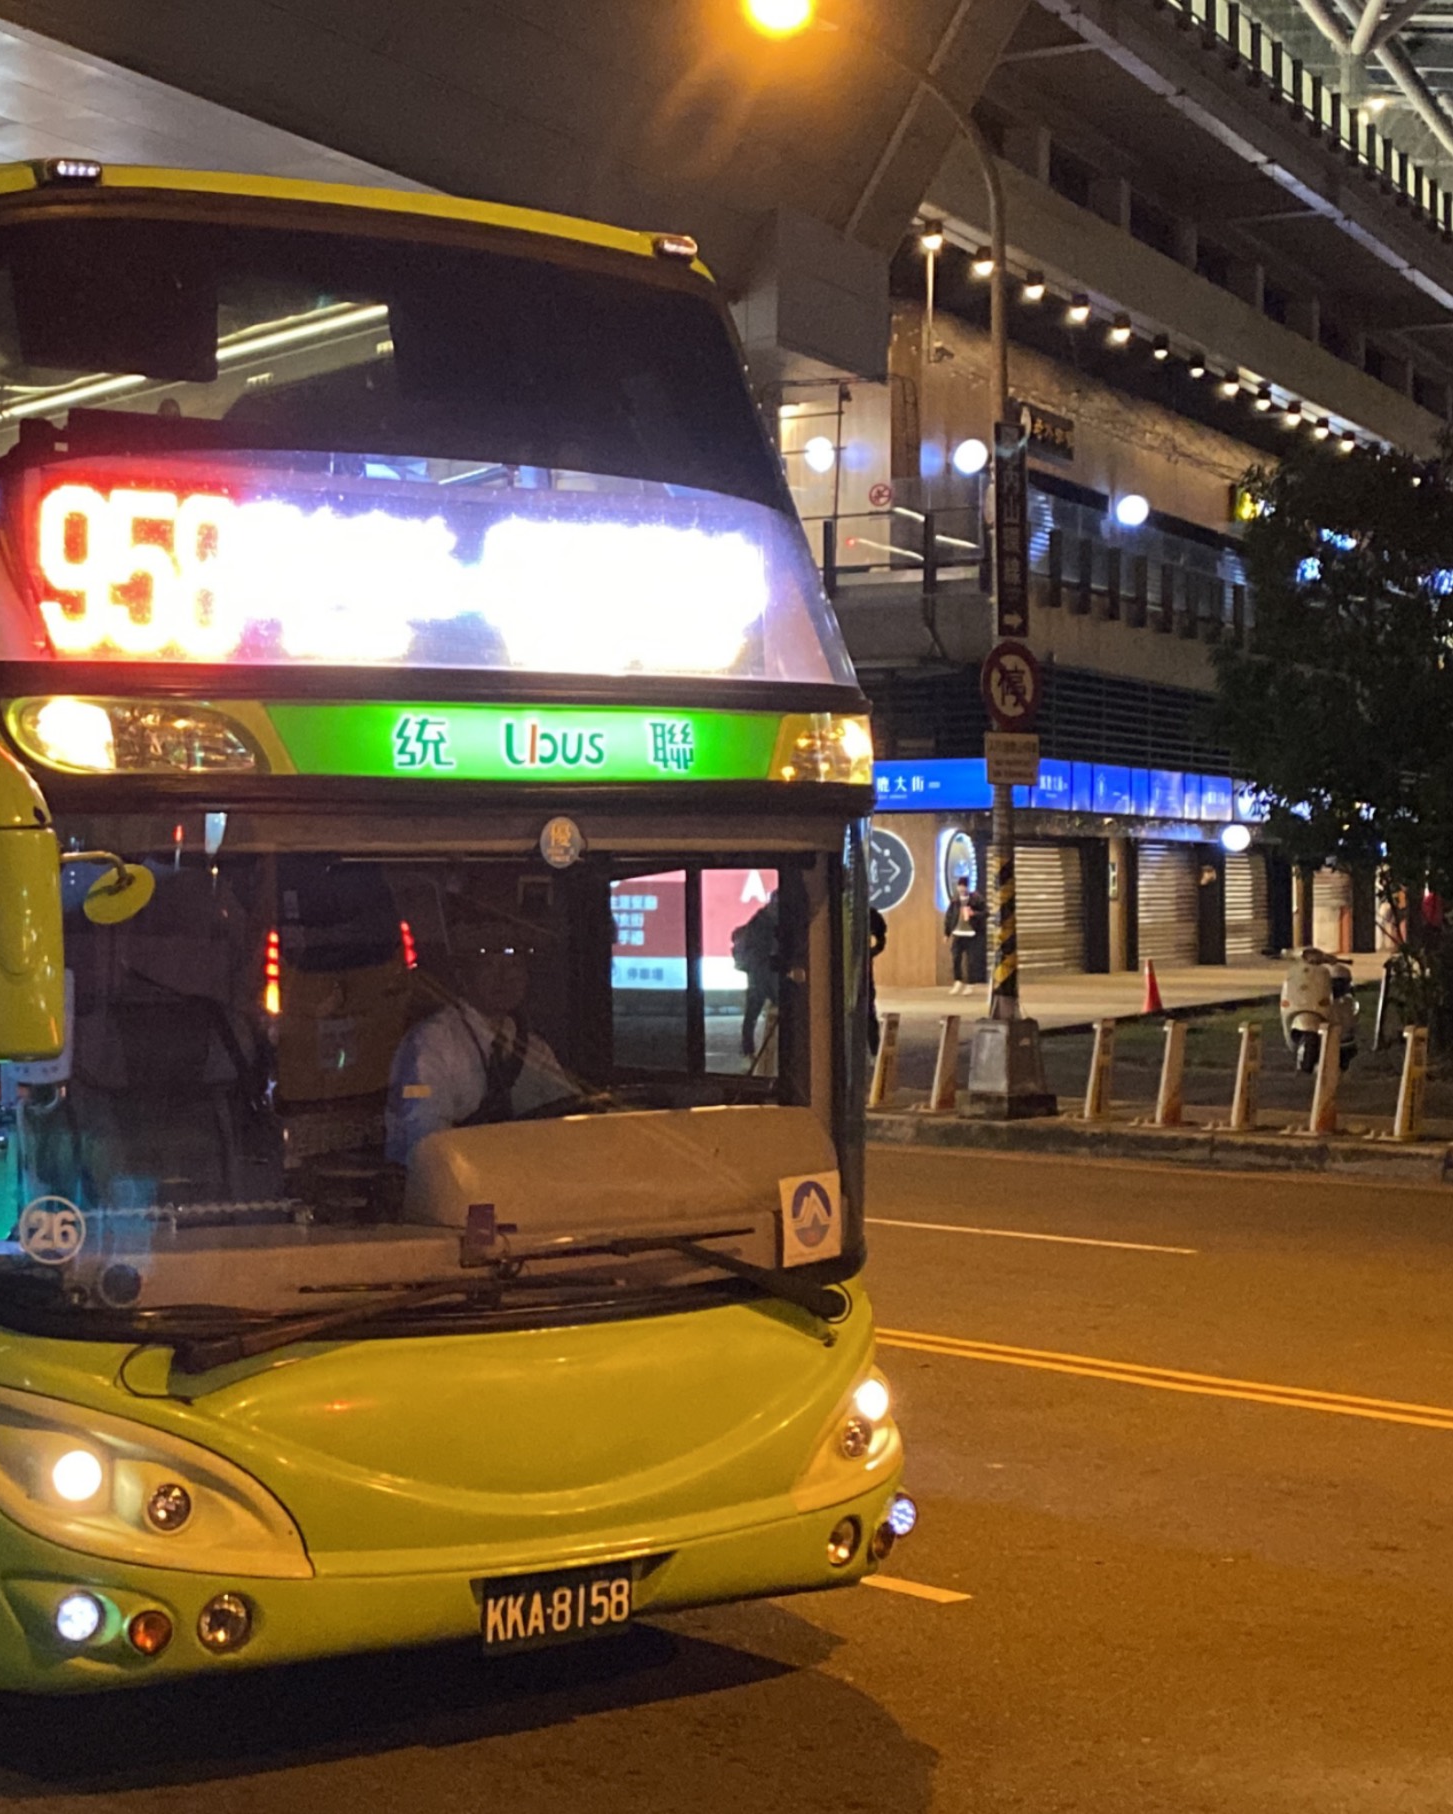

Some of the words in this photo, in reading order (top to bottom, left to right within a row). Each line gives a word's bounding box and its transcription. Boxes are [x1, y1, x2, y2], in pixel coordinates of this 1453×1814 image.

[40, 484, 240, 654] 958
[27, 1209, 78, 1250] 26
[486, 1578, 630, 1643] KKA-8158
